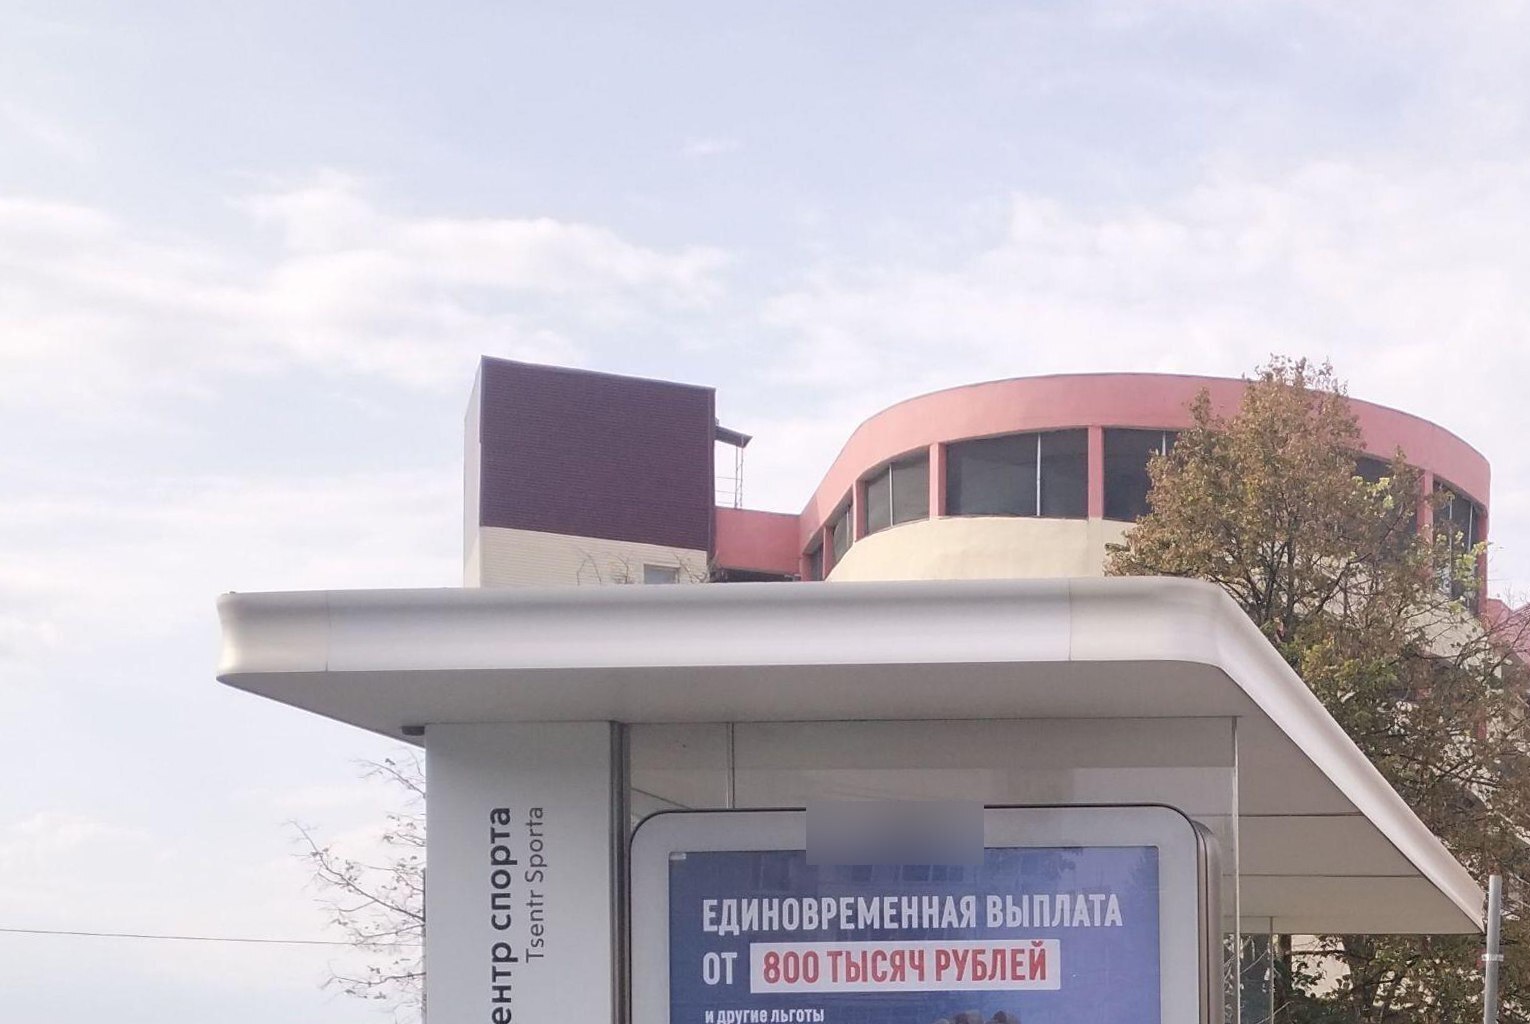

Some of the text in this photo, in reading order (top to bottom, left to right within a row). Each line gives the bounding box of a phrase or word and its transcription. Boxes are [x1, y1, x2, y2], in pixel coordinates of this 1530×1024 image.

[490, 807, 518, 930] спорта
[525, 806, 547, 963] Tsentr Sporta
[703, 894, 1123, 935] ЕДИНОВРЕМЕННАЯ ВЫПЛАТА
[703, 940, 1046, 985] ОТ 800 ТЫСЯЧ РУБЛЕЙ
[705, 1010, 713, 1024] и
[771, 1009, 824, 1023] льготы
